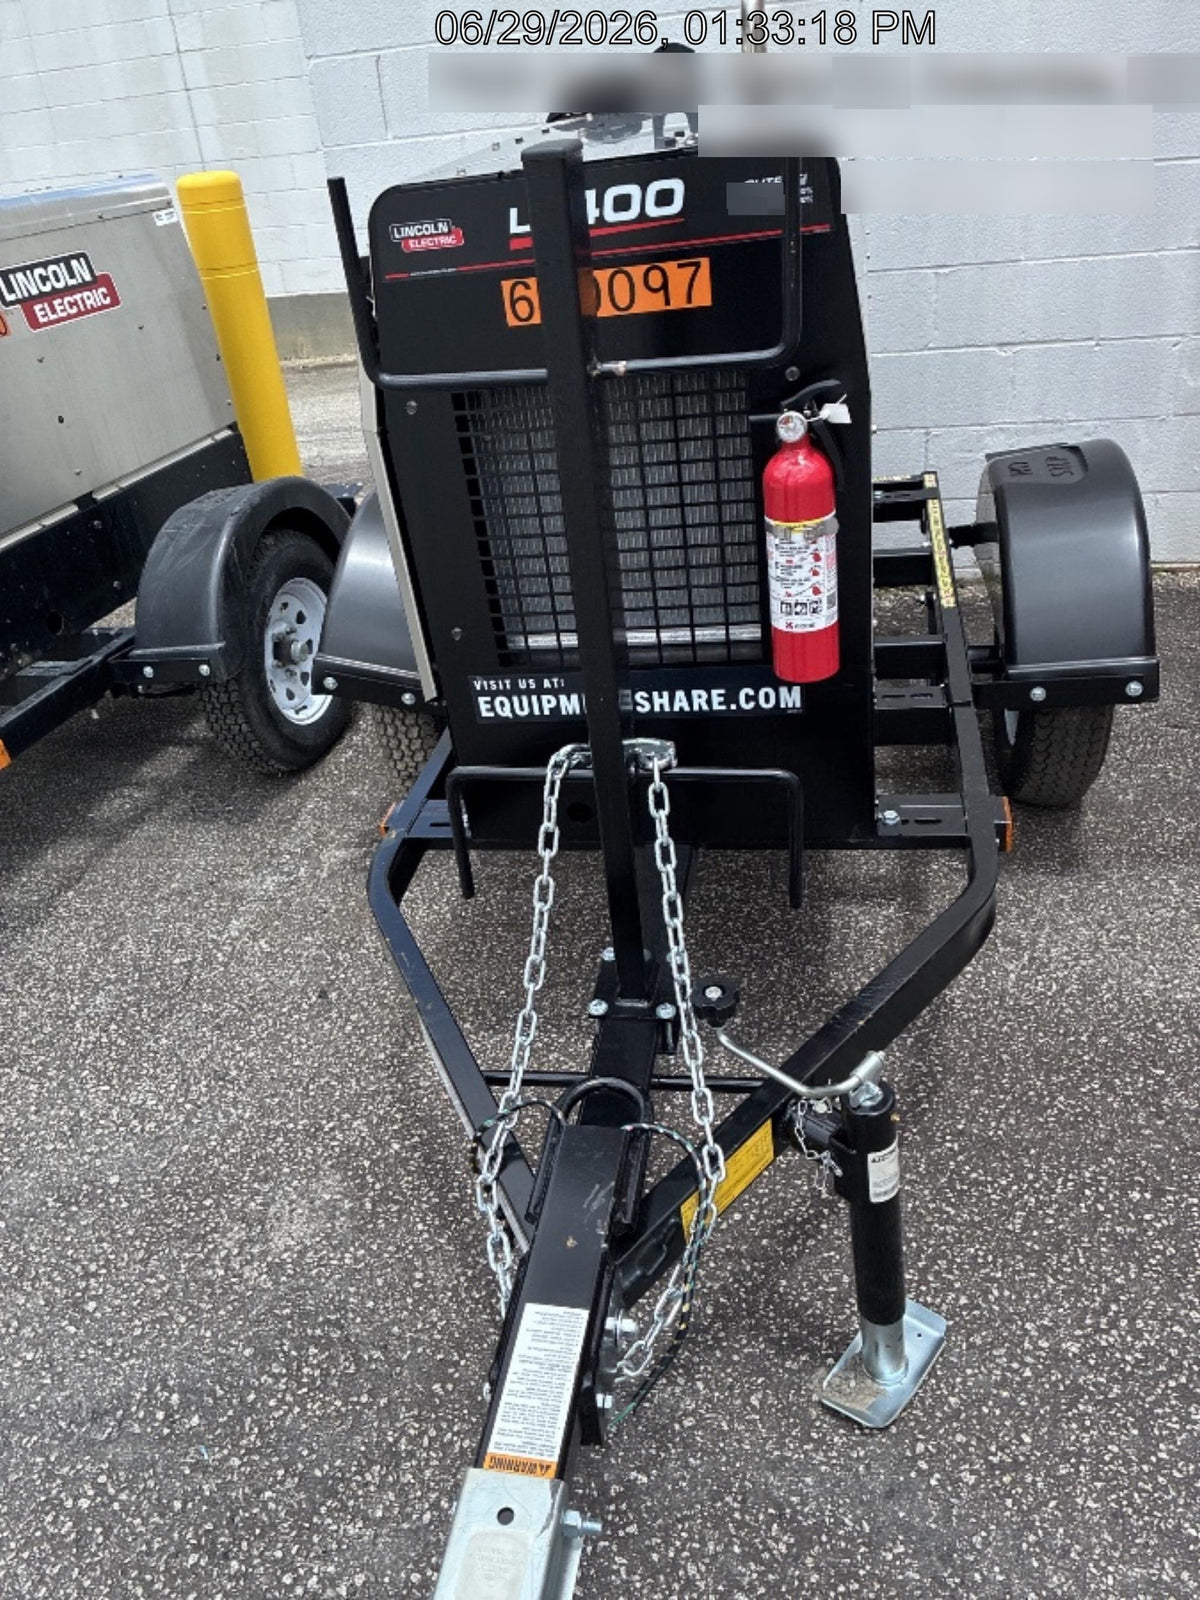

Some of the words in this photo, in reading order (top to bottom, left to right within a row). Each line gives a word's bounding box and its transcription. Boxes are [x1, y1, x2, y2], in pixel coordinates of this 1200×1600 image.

[393, 222, 449, 239] LINCOLN
[408, 235, 457, 249] ELECTRIC
[0, 258, 93, 302] LINCOLN
[509, 260, 703, 323] 6097
[33, 287, 111, 323] ELECTRIC
[473, 679, 511, 691] VISIT
[518, 678, 536, 689] US
[488, 1455, 538, 1475] WARNING
